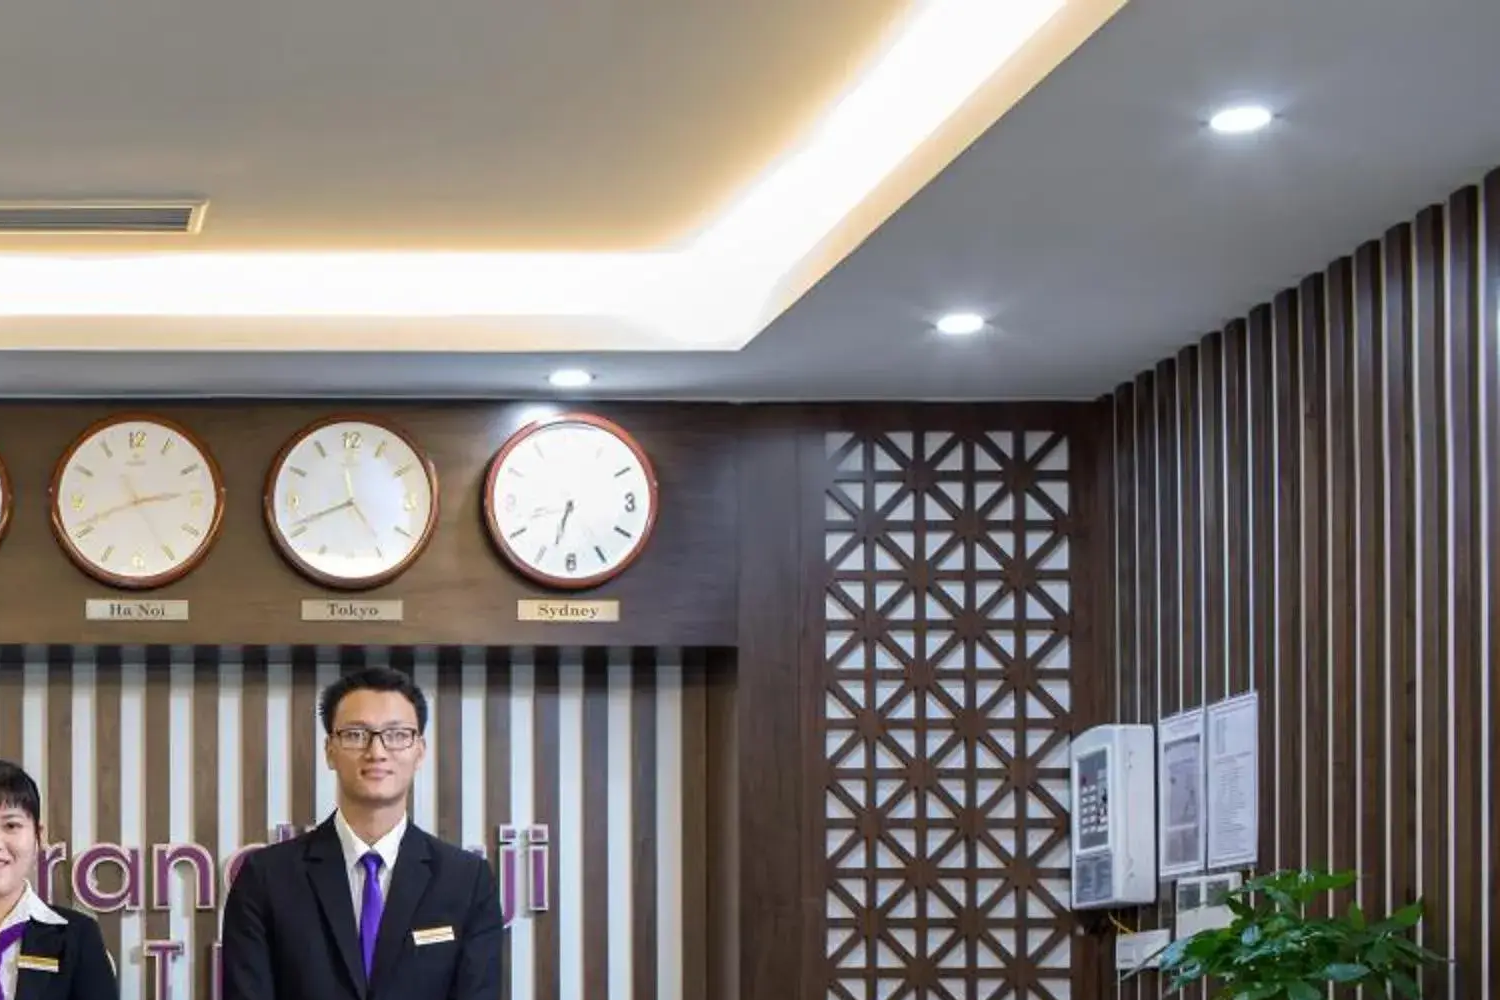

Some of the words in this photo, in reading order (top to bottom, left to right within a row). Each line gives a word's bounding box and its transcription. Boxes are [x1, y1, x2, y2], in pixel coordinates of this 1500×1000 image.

[129, 431, 146, 449] 12
[341, 431, 361, 449] 12
[624, 492, 636, 512] 3
[565, 553, 577, 571] 6
[109, 602, 132, 617] Ha
[138, 602, 166, 617] Noi
[327, 603, 379, 620] Tokyo
[537, 603, 600, 619] Sydney
